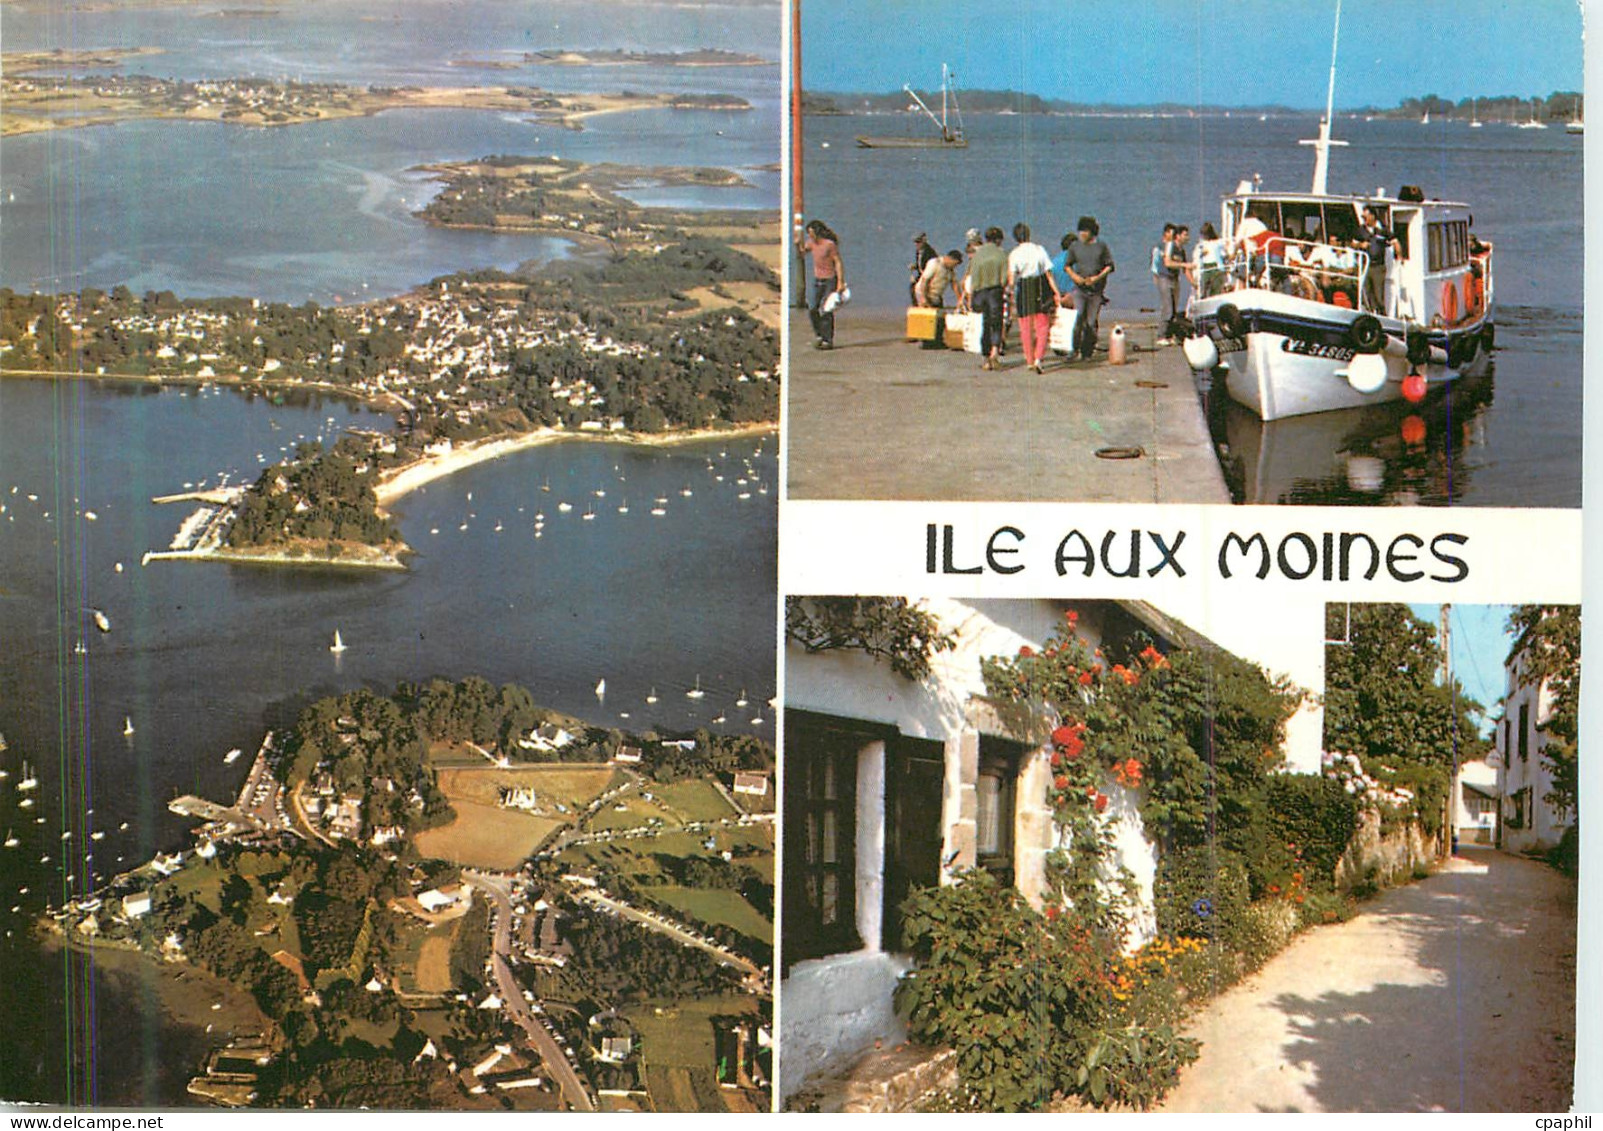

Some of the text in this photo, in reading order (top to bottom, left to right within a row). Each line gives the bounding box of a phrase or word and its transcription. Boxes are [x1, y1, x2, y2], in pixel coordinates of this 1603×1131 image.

[926, 523, 1470, 583] ILE AUX MOINES
